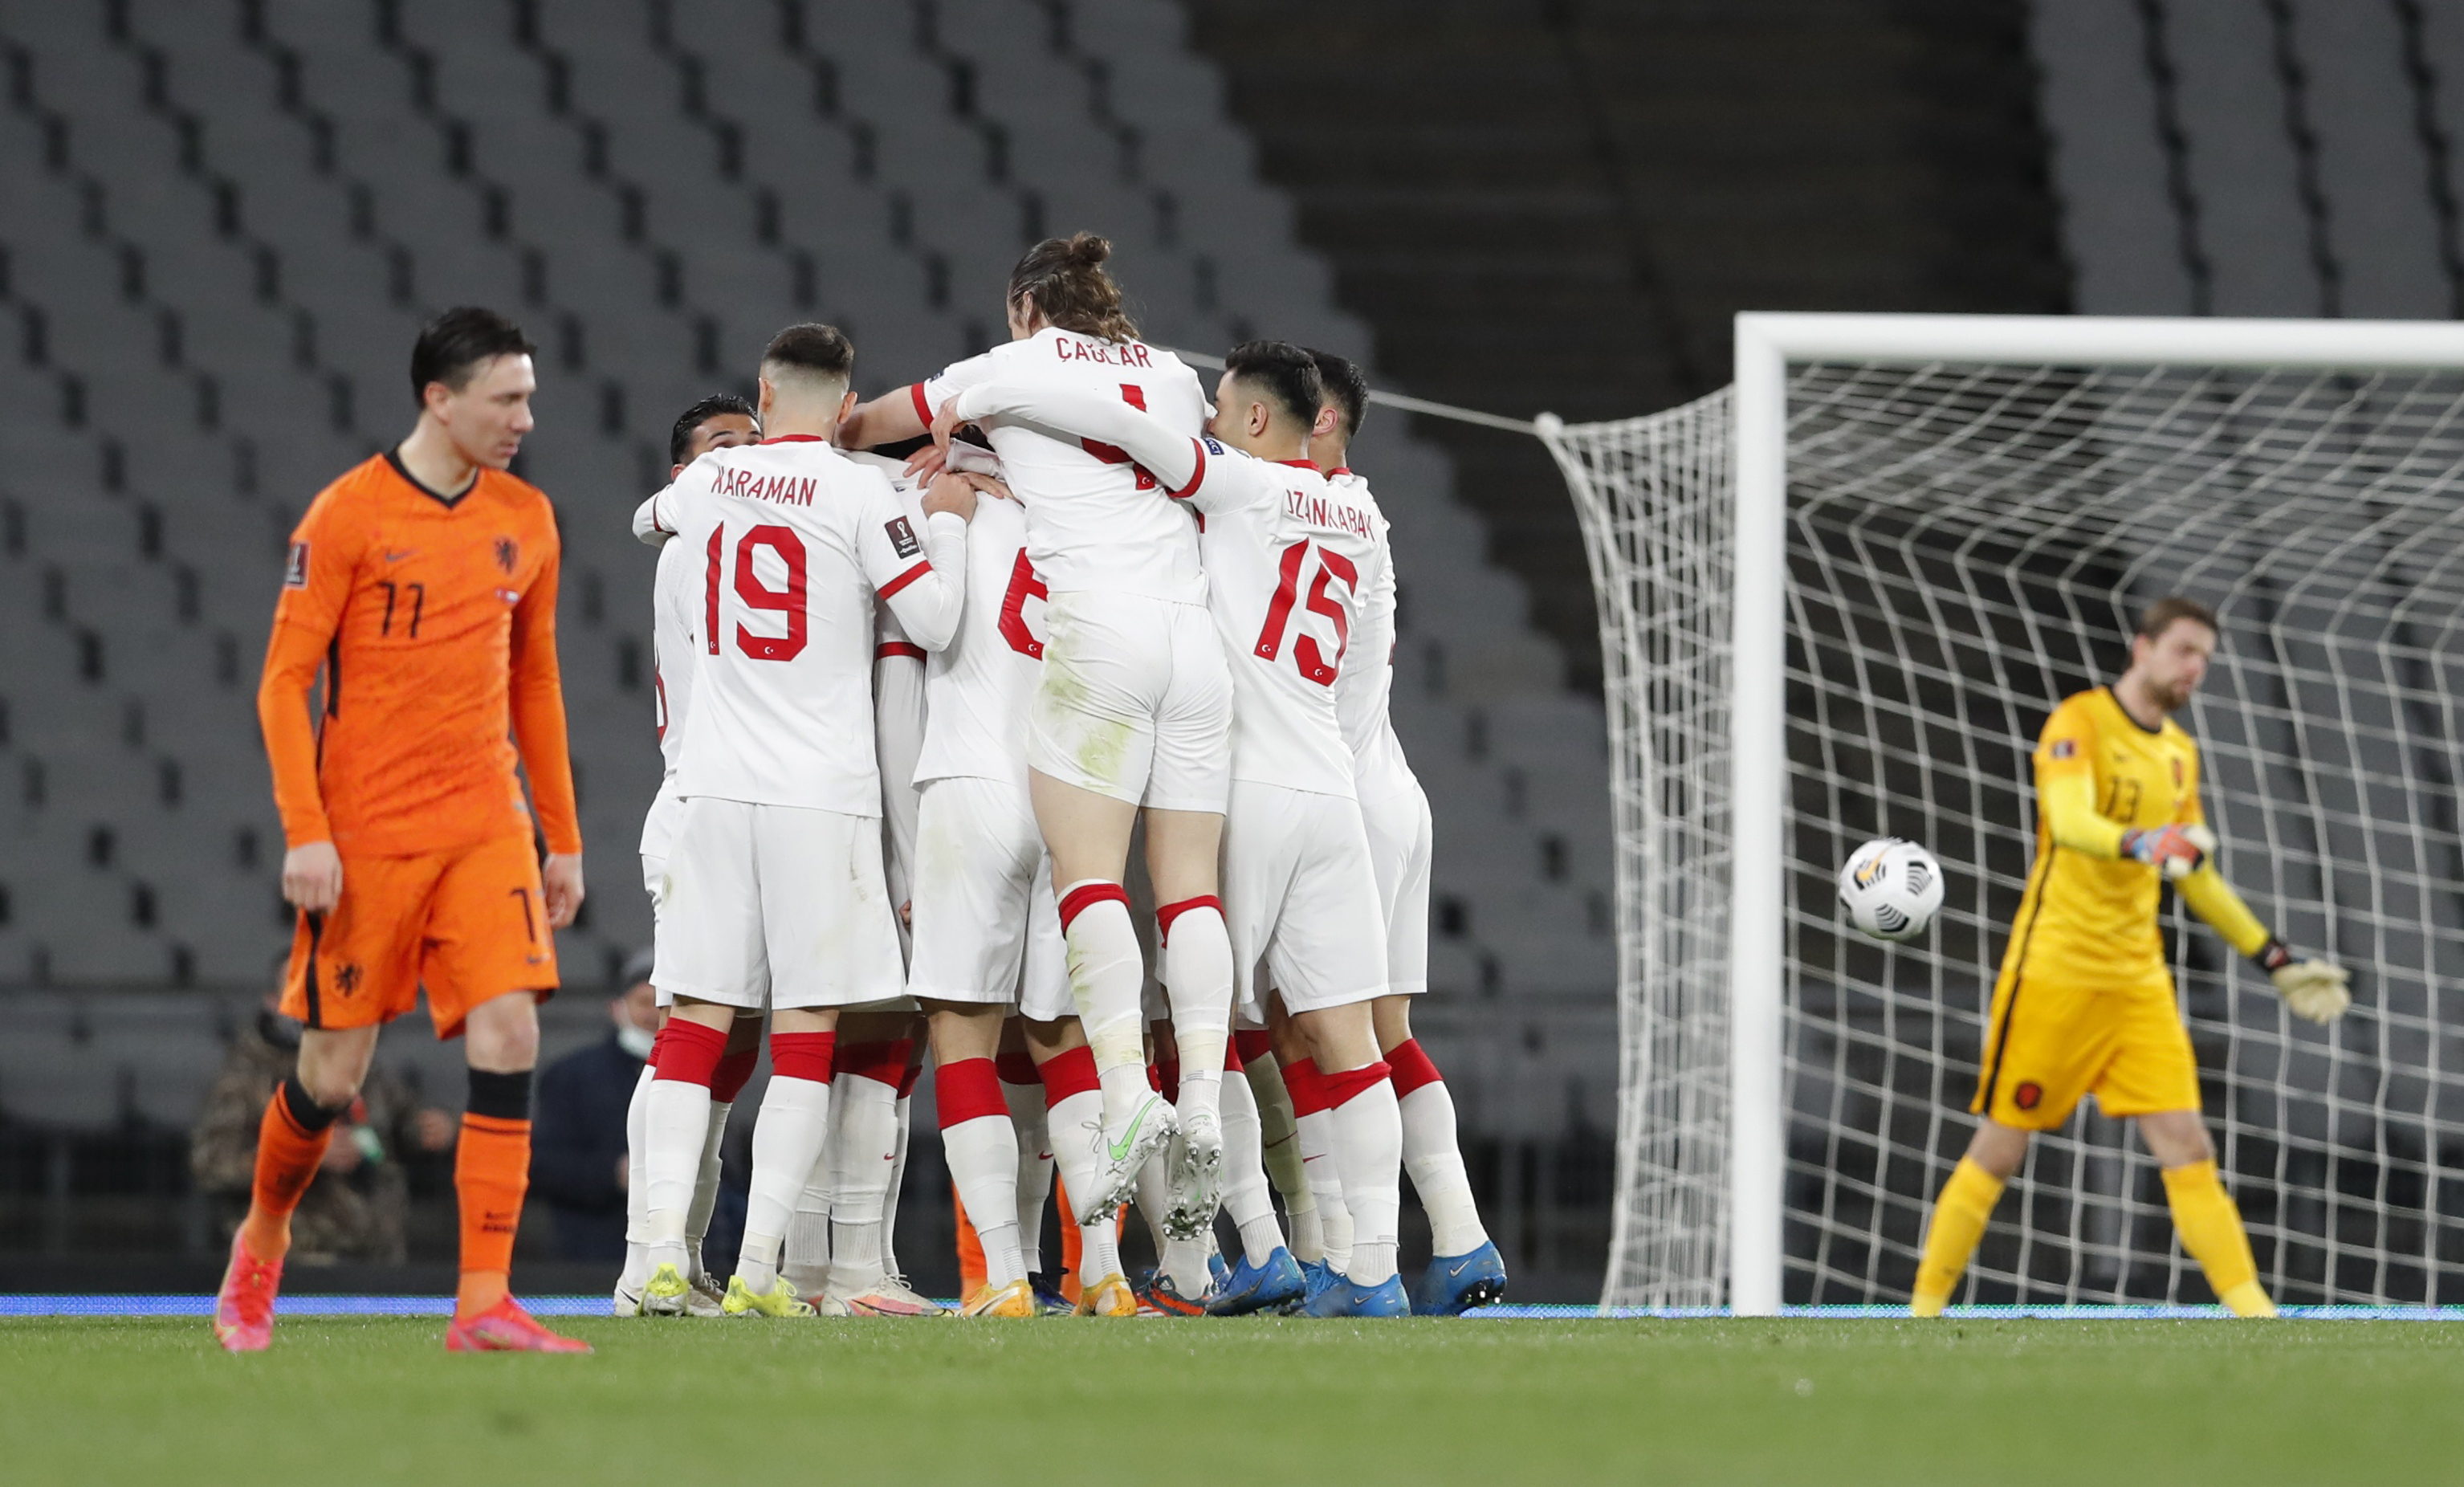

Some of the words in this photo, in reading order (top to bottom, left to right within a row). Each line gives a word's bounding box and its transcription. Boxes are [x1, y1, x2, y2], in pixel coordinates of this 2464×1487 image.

[711, 466, 817, 507] KARAMAN
[376, 581, 424, 639] 11
[706, 520, 807, 662] 19
[1253, 535, 1358, 687] 15
[2104, 776, 2142, 825] 13
